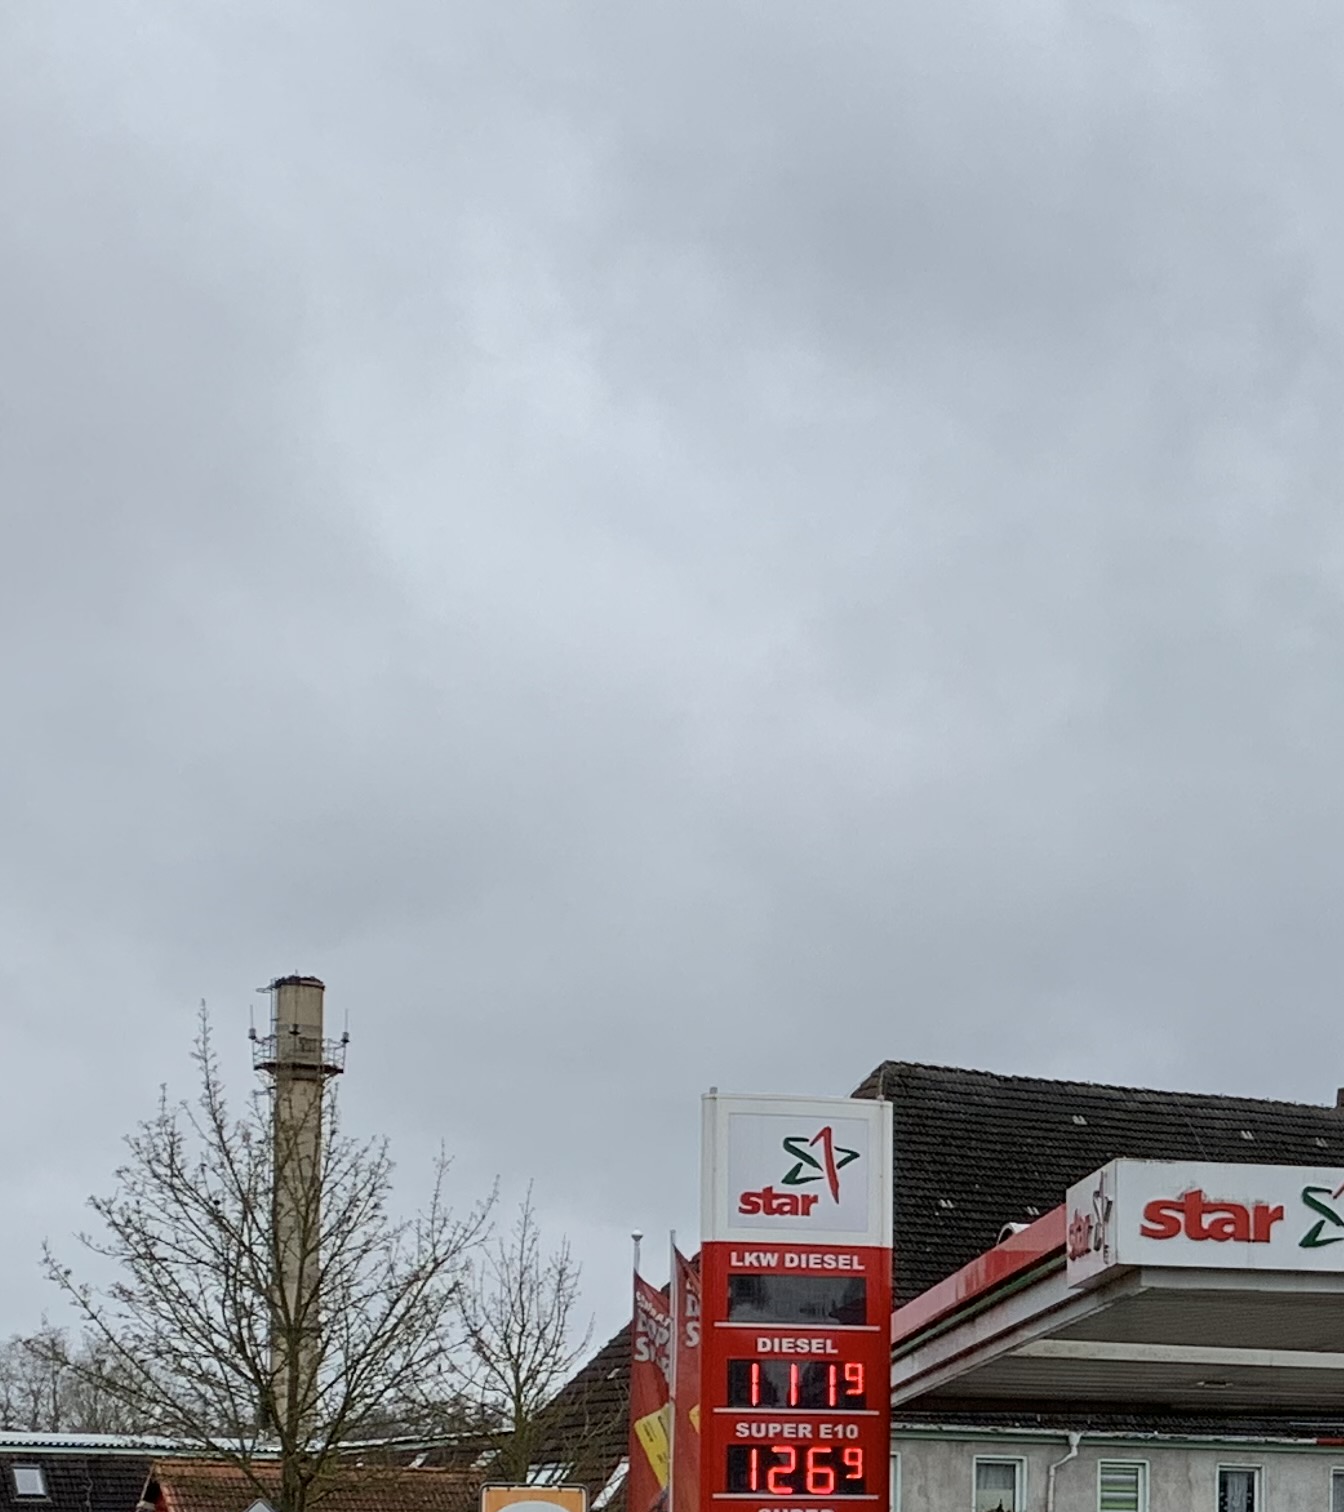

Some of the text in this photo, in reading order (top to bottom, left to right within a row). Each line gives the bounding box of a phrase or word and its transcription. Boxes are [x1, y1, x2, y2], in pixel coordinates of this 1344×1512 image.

[738, 1186, 819, 1217] star
[1140, 1190, 1285, 1243] star
[730, 1251, 866, 1271] LKW DIESEL
[756, 1337, 839, 1354] DIESEL
[751, 1362, 864, 1406] 1119
[735, 1422, 859, 1439] SUPER E10
[751, 1445, 864, 1494] 1269
